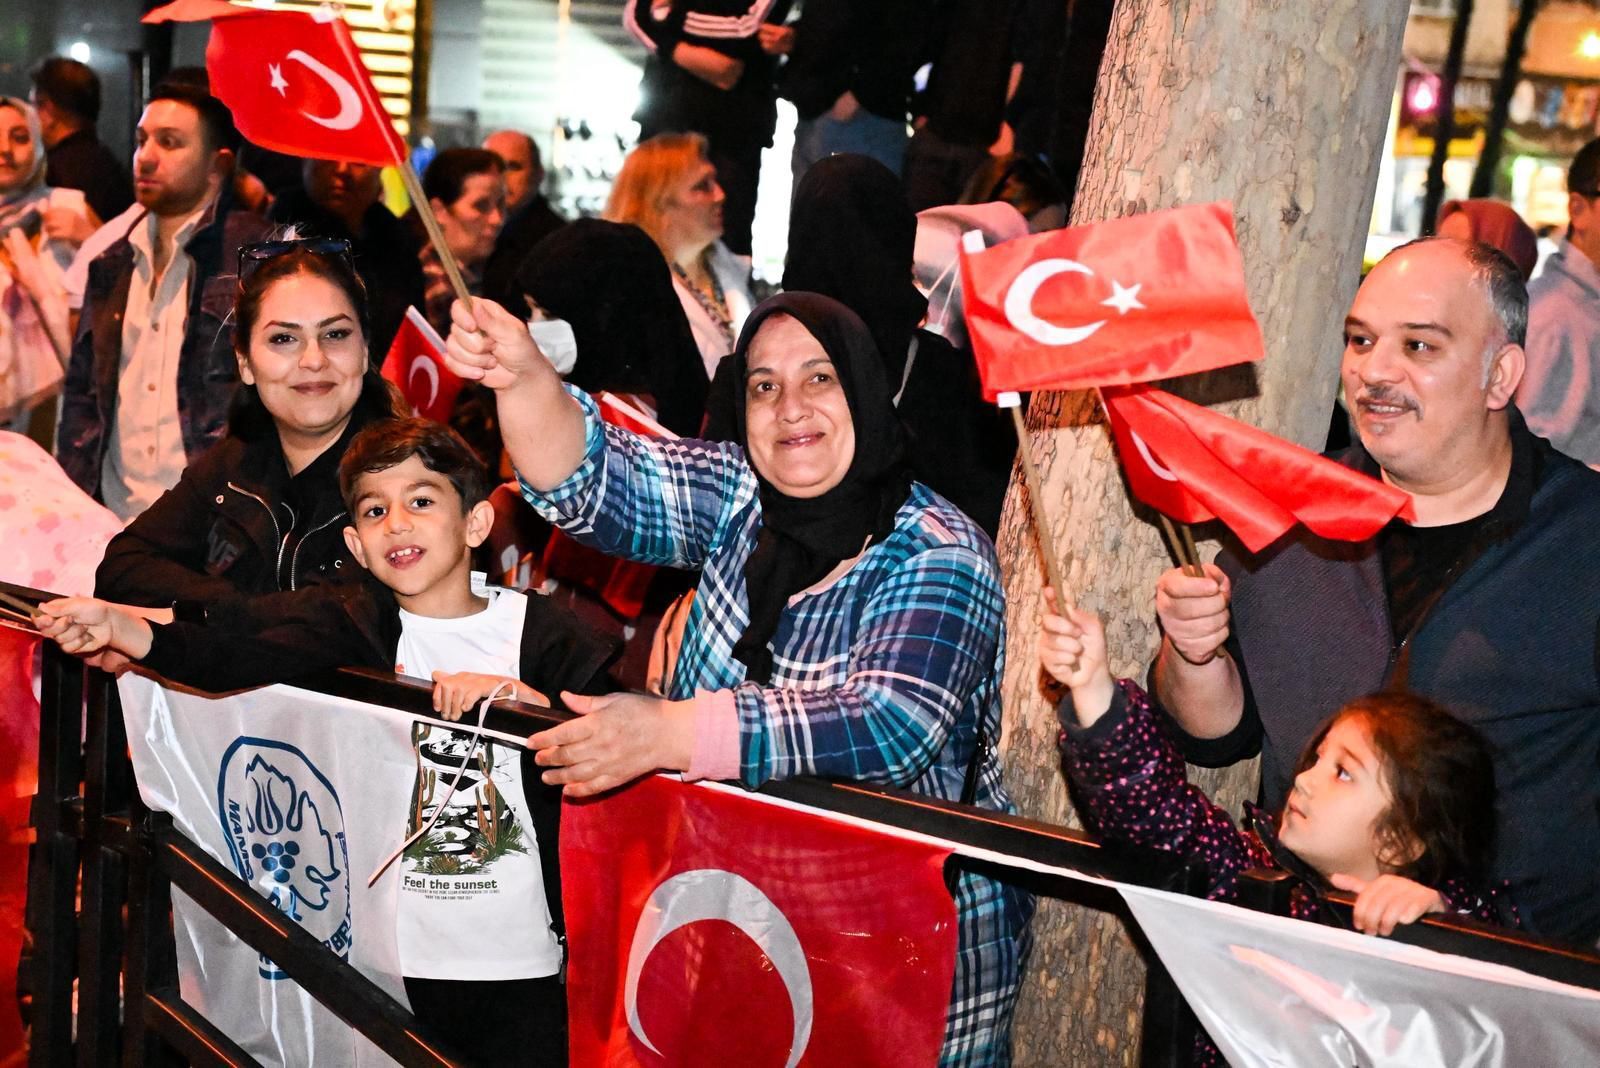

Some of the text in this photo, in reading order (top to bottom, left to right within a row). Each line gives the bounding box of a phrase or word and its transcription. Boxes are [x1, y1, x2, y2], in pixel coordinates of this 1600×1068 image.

[404, 875, 426, 888] Feel
[429, 878, 450, 889] the
[454, 879, 498, 890] sunset
